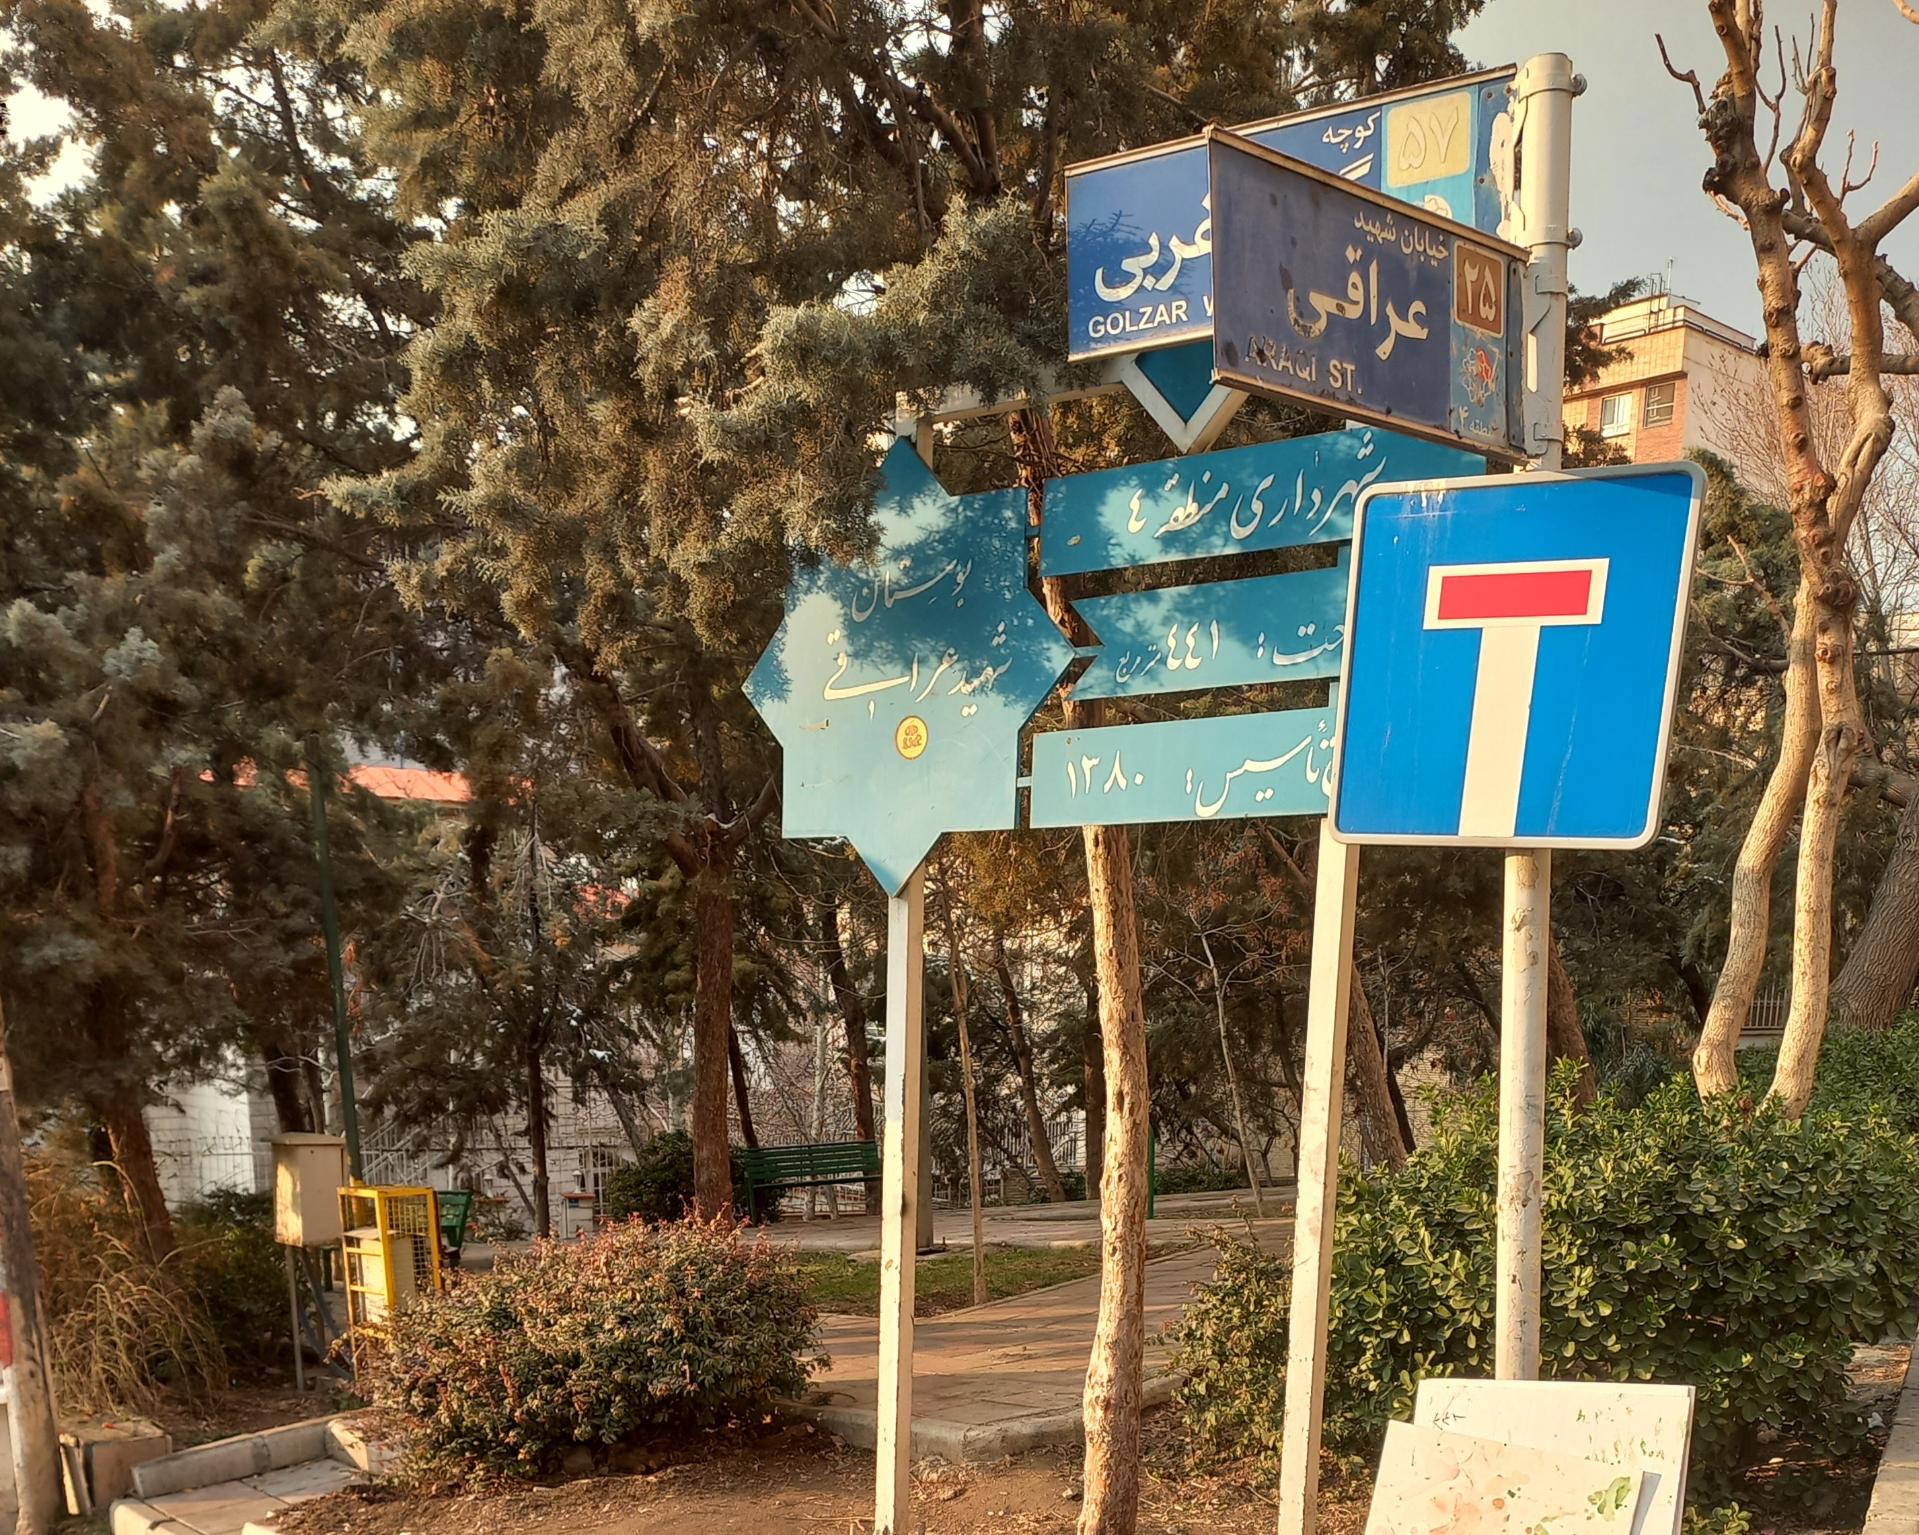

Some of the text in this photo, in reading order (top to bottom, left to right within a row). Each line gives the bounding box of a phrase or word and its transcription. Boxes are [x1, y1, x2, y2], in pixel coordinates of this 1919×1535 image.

[1322, 111, 1381, 153] کوچه
[1399, 104, 1459, 171] ۵۷
[1354, 211, 1449, 267] خیابان شهید
[1088, 300, 1188, 338] GOLZAR
[1287, 243, 1429, 361] عراقی
[1463, 259, 1497, 322] ۲۵
[1328, 359, 1363, 394] ST.
[1230, 431, 1387, 541] شهرداری
[852, 556, 972, 622] بوستان
[948, 620, 1013, 717] شهید
[1066, 750, 1144, 799] ۱۳۸۰
